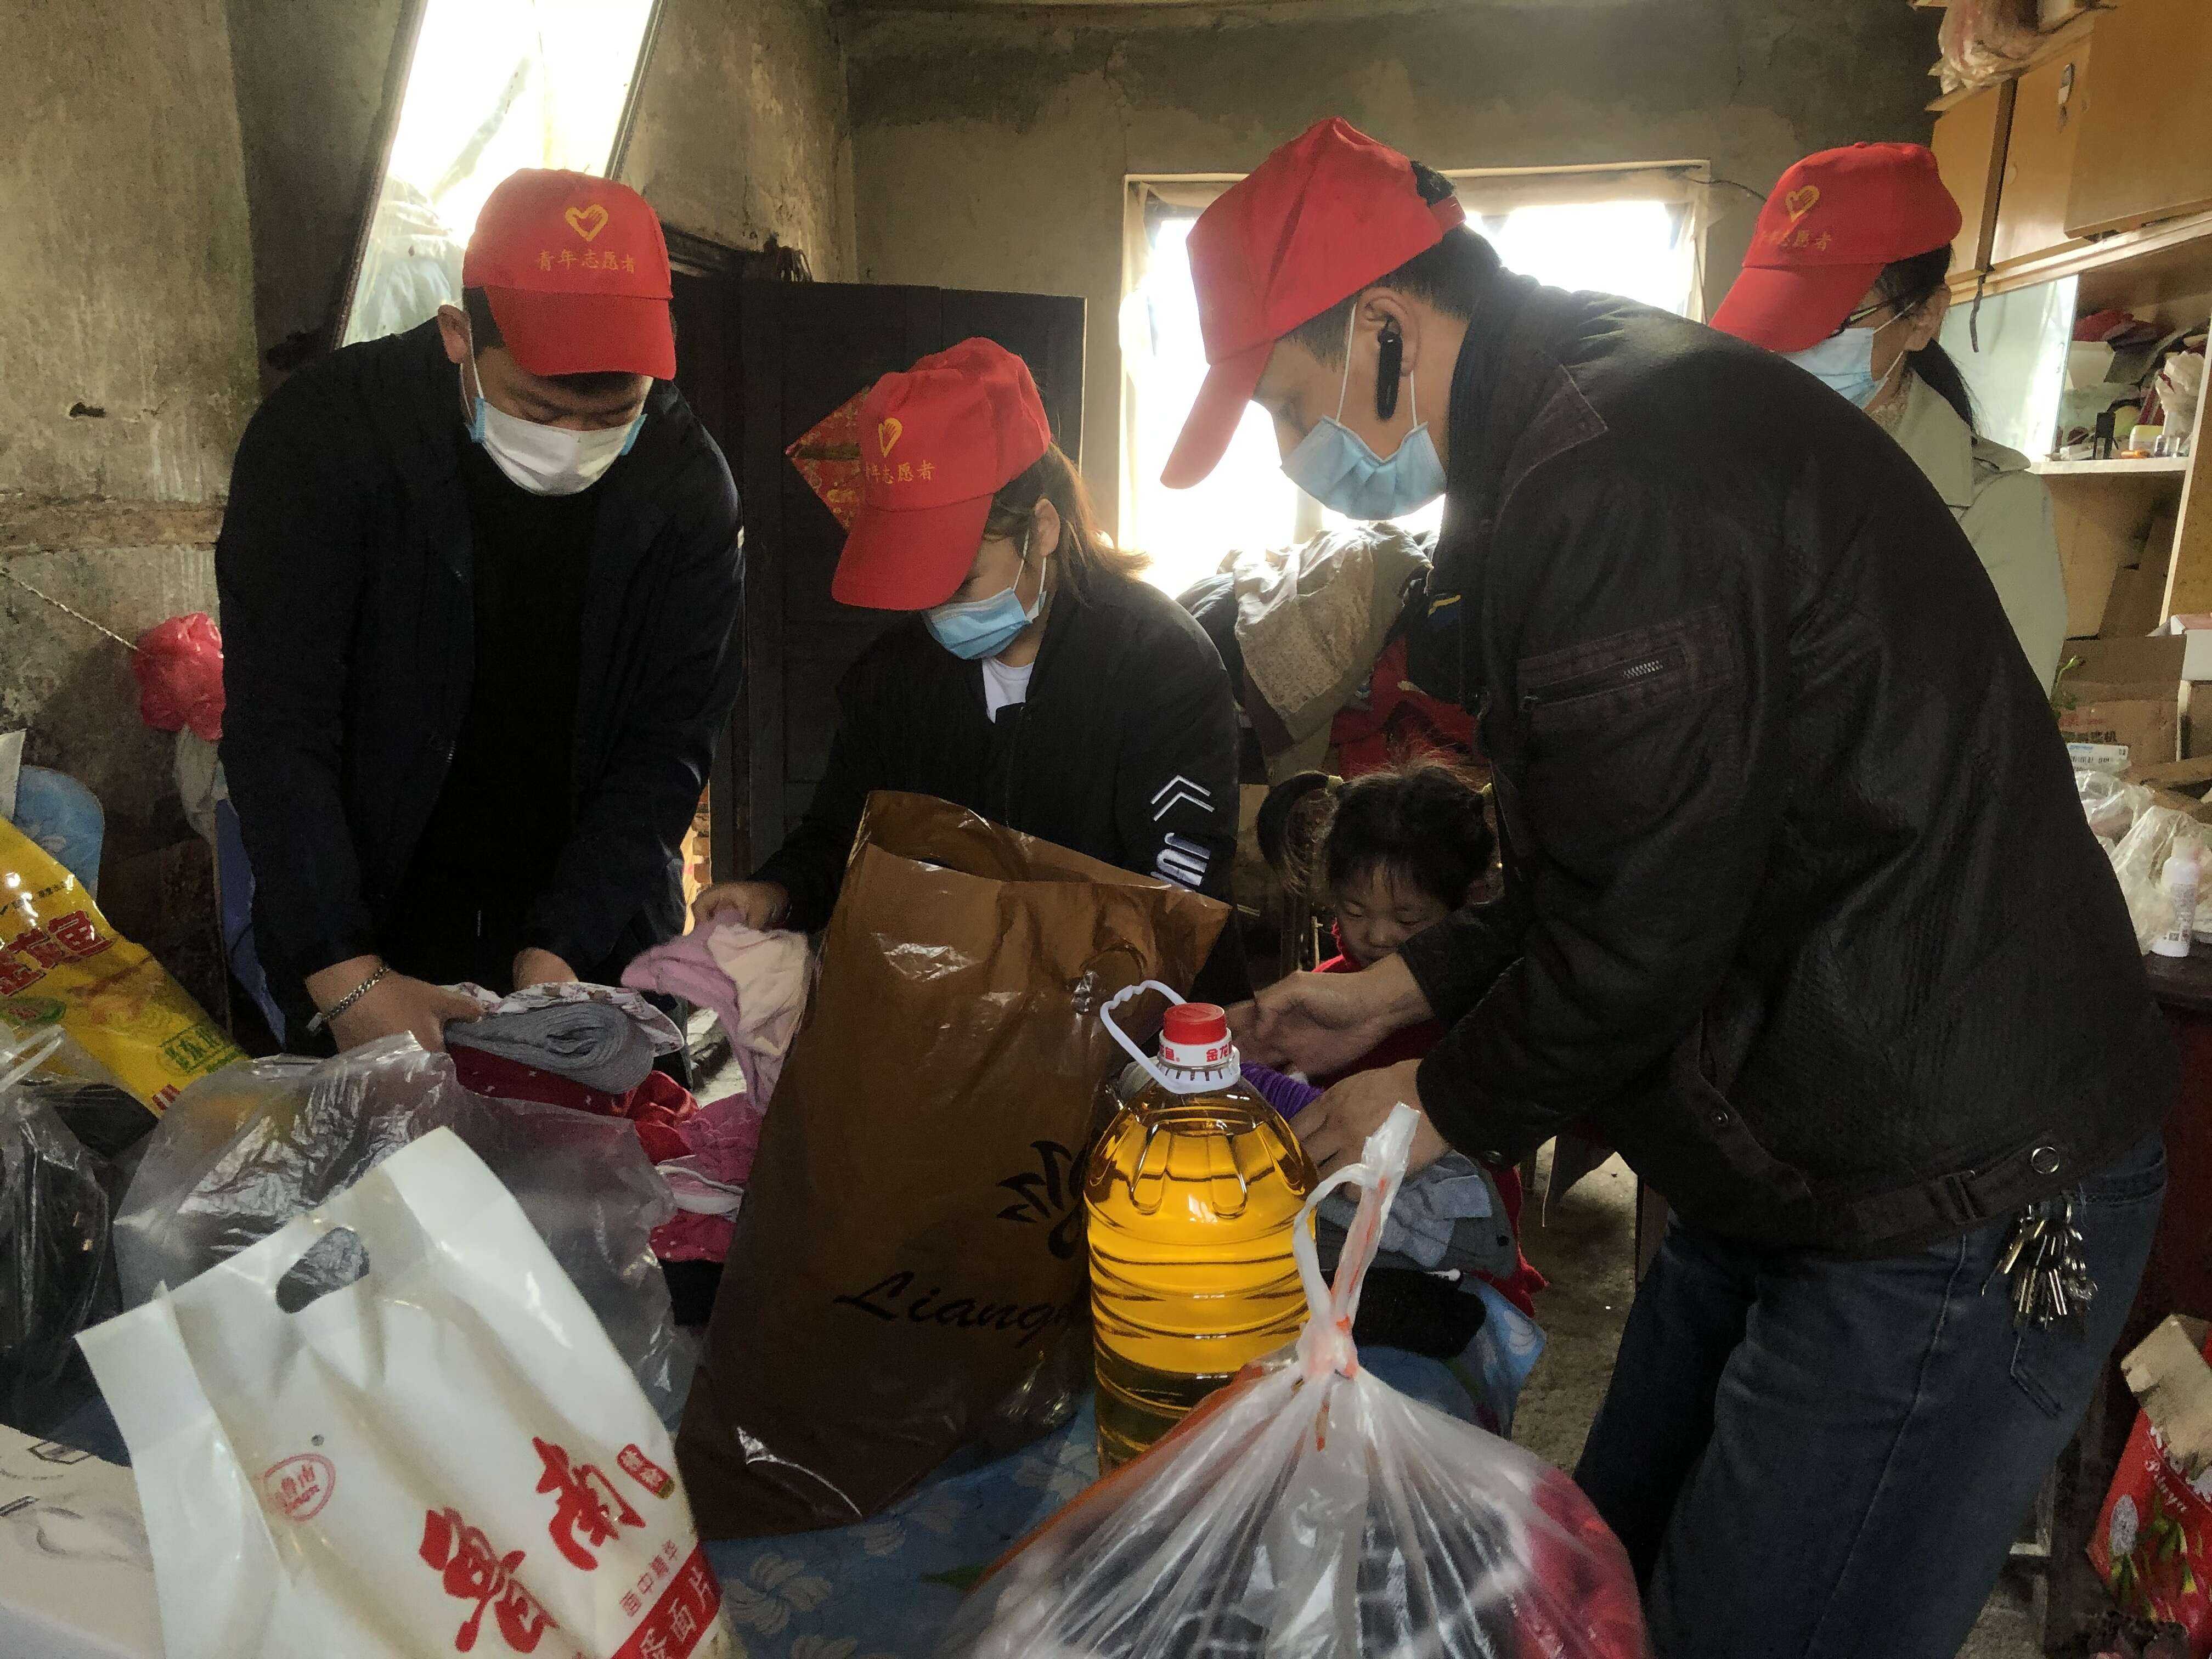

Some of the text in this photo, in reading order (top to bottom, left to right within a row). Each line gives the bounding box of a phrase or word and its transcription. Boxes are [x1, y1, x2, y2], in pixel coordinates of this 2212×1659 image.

[535, 247, 634, 273] 青年志愿者
[832, 1270, 1068, 1348] Liang
[420, 1437, 645, 1652] 鲁南
